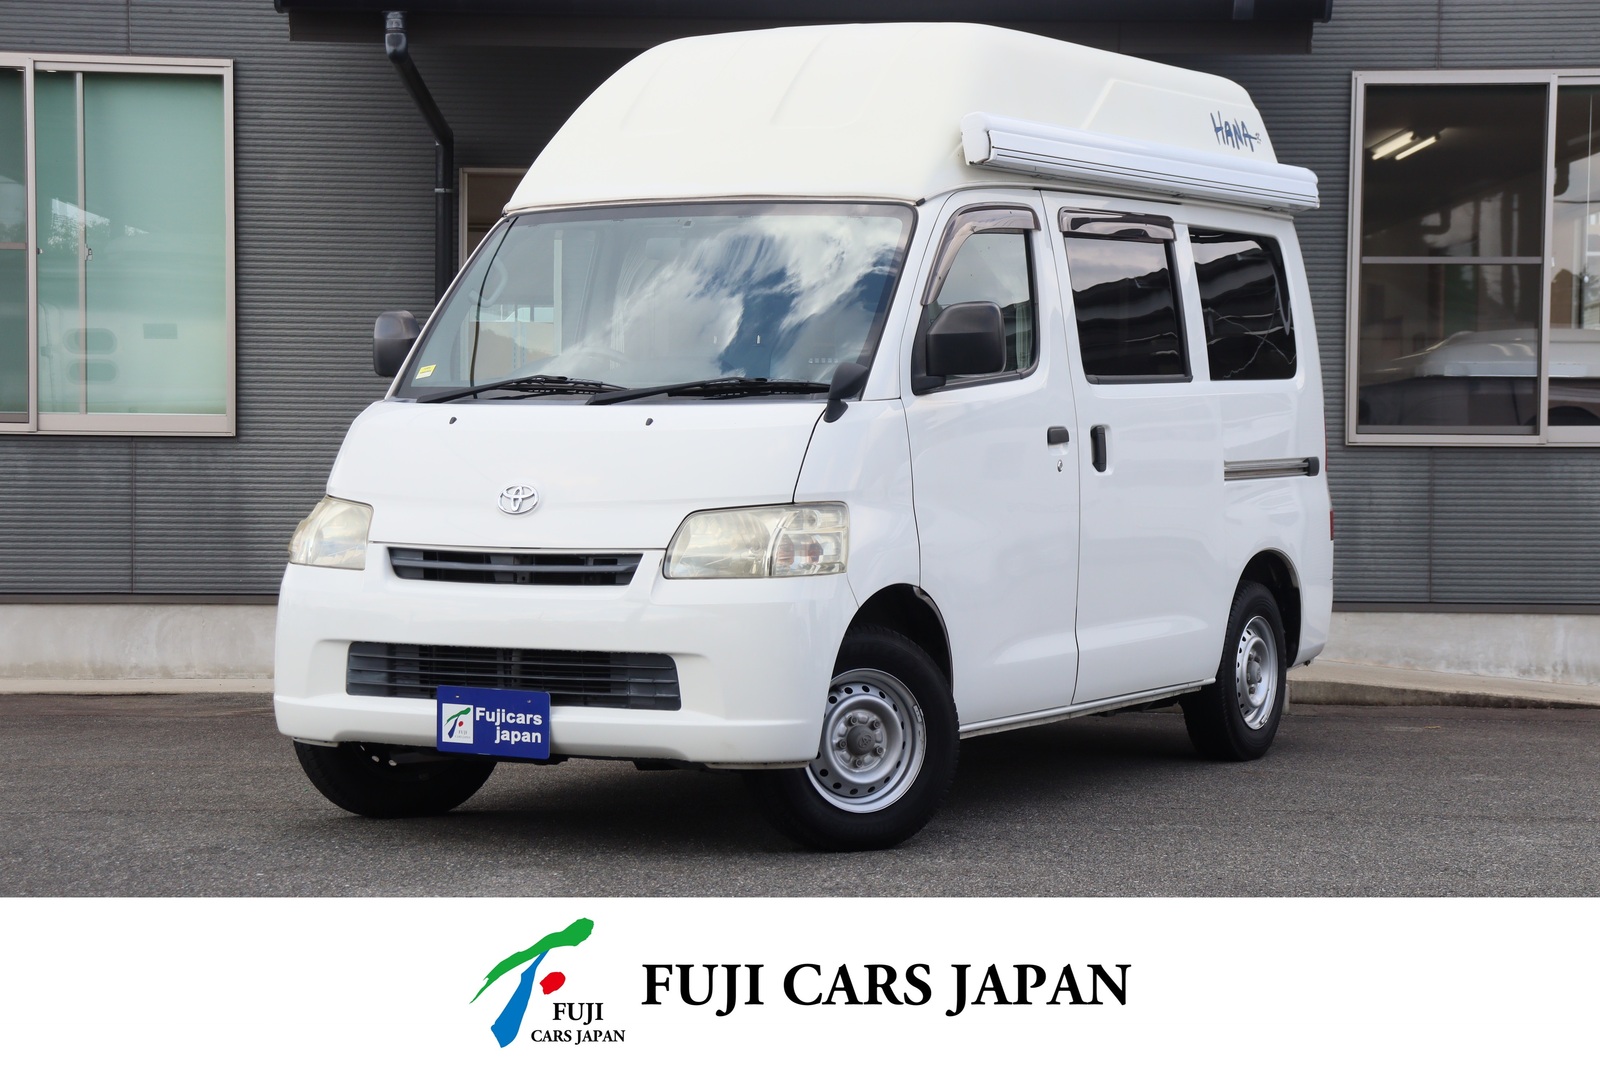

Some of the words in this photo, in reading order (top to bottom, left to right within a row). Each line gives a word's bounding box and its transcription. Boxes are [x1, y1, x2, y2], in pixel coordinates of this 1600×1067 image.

[1210, 110, 1256, 152] HANA
[475, 707, 543, 726] Fujicars
[494, 726, 542, 744] japan
